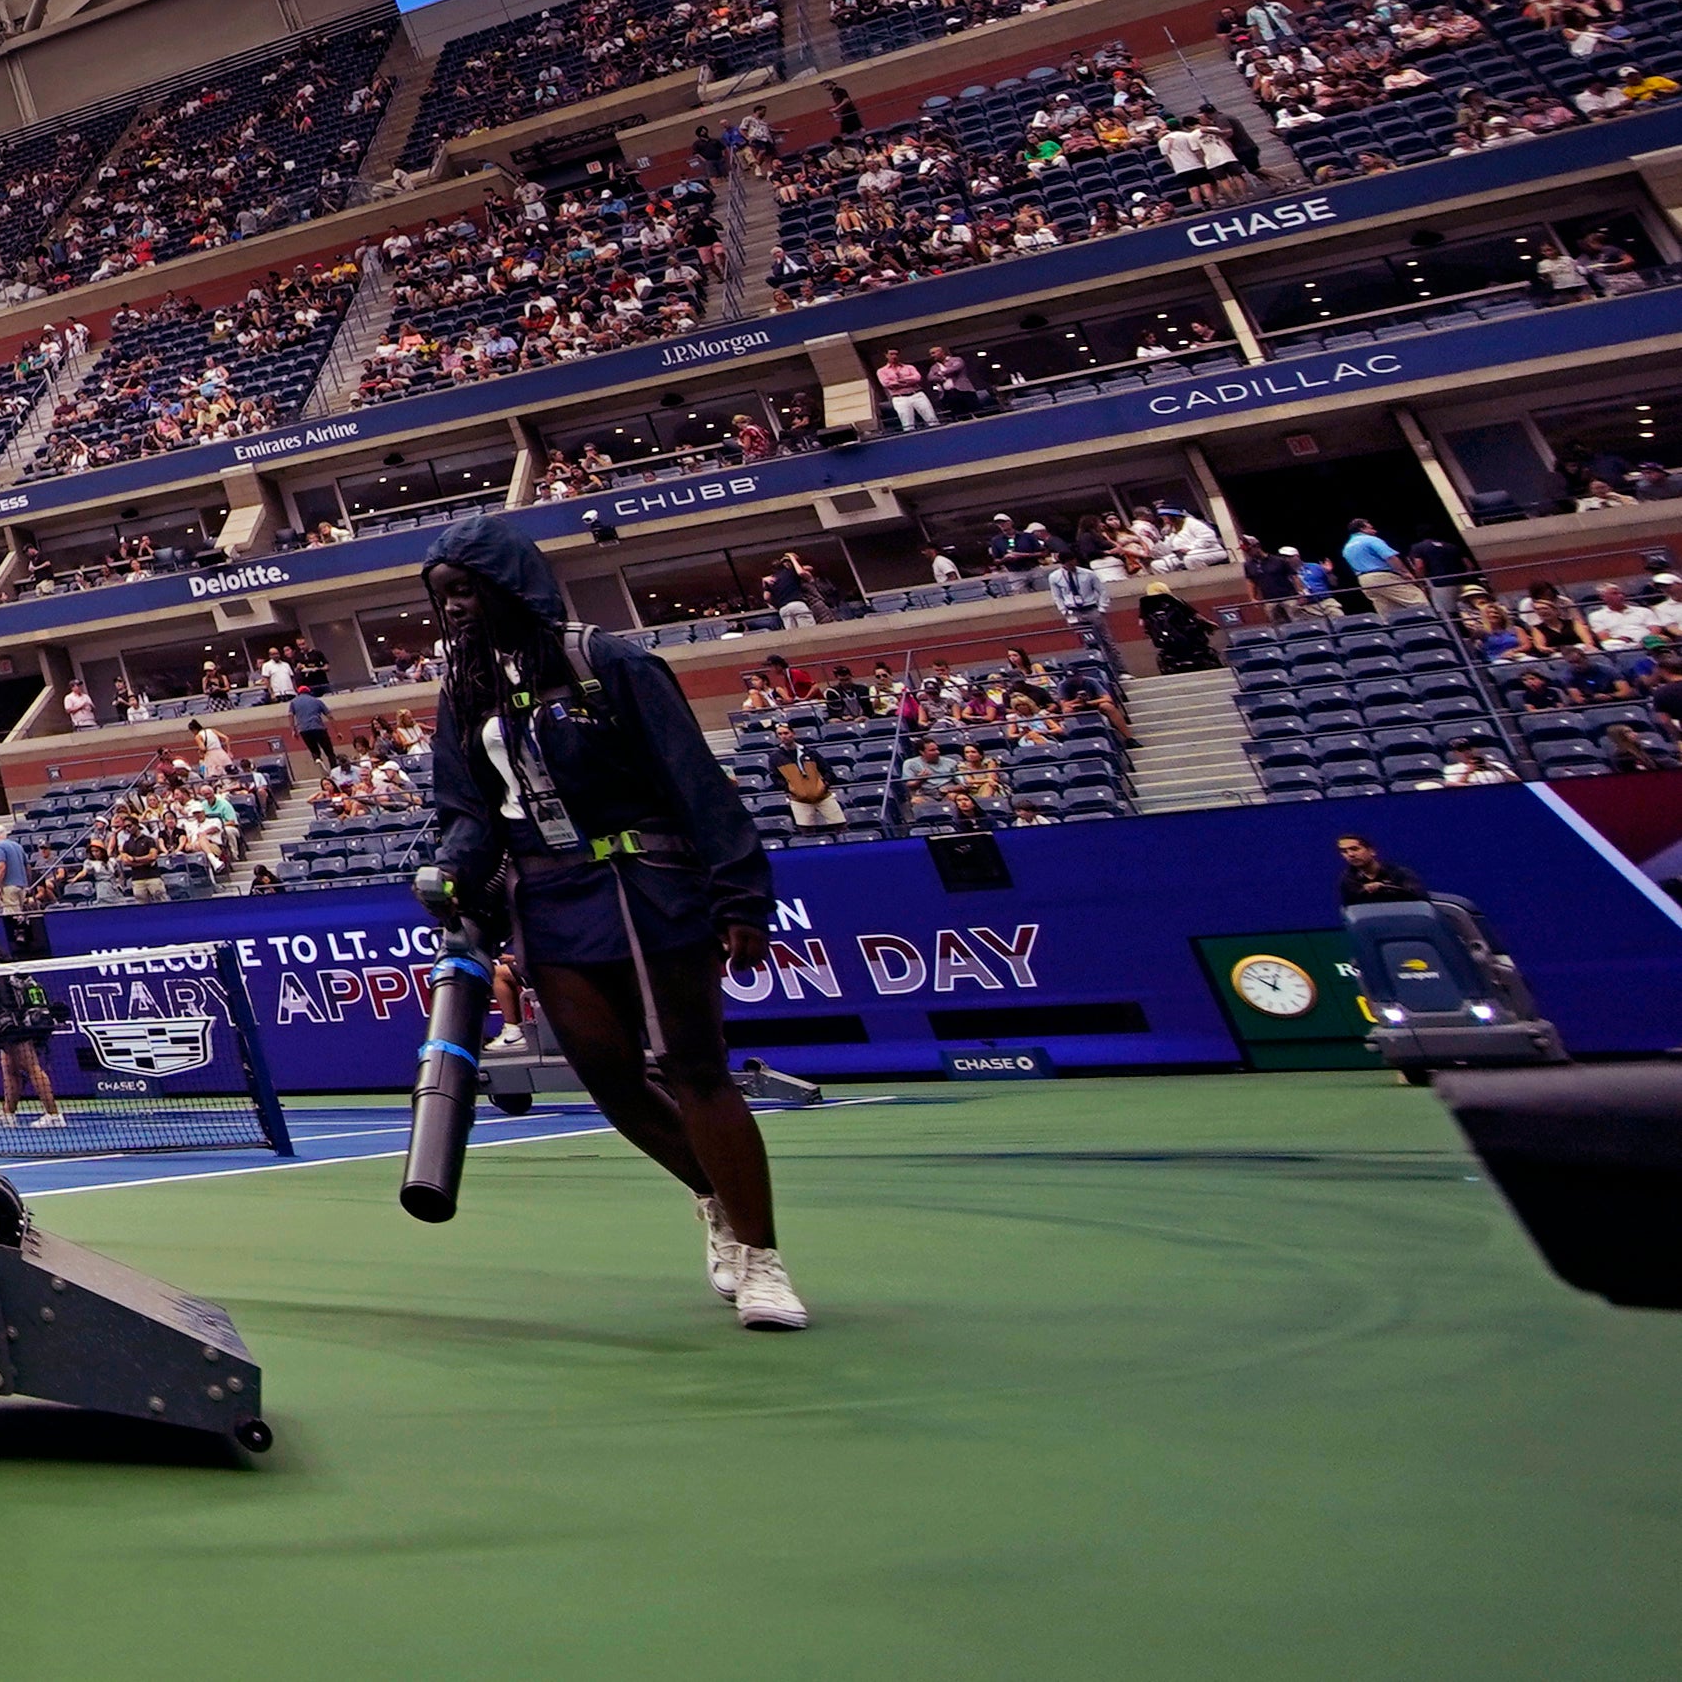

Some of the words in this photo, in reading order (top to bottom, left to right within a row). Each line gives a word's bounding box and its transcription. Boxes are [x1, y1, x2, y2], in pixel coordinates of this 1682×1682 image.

[1187, 196, 1337, 247] CHASE
[661, 331, 771, 367] J.P.Morgan
[1148, 354, 1402, 416] CADILLAC
[235, 436, 302, 462] Emirates
[304, 419, 360, 449] Airline
[614, 478, 757, 517] CHUBB
[187, 564, 291, 598] Deloitte.
[267, 934, 318, 965] TO
[326, 930, 378, 961] LT.
[856, 923, 1040, 995] DAY
[953, 1056, 1016, 1071] CHASE
[97, 1080, 136, 1092] CHASE
